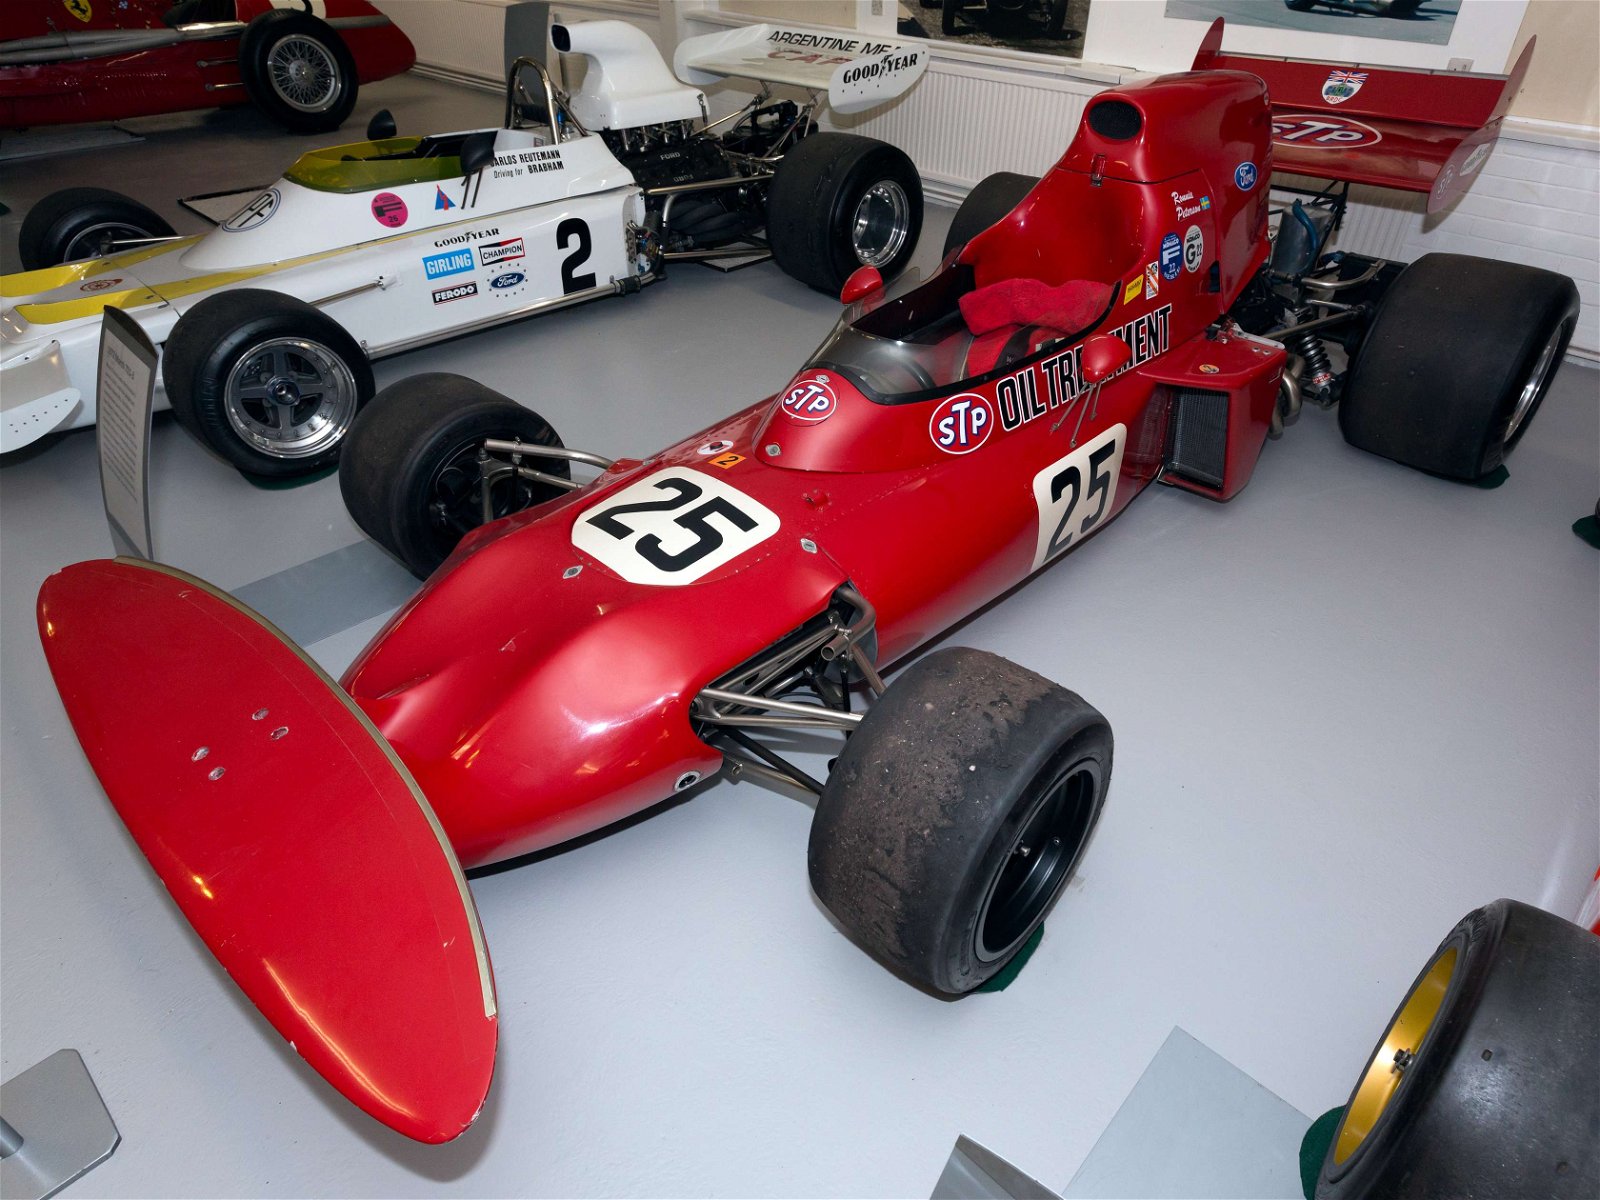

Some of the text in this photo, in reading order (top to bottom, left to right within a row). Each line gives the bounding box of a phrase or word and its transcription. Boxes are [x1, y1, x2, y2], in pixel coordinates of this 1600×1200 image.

[767, 31, 859, 52] ARGENTINE
[843, 53, 918, 84] GOODYEAR
[519, 149, 561, 163] REUTEMANN
[493, 160, 565, 179] Driving for BRABHAM
[1239, 165, 1255, 187] Ford
[434, 227, 501, 248] GOODYEAR
[482, 243, 523, 260] CHAMPION
[556, 217, 597, 295] 2
[1162, 245, 1181, 265] F
[1186, 243, 1197, 265] G
[426, 252, 472, 276] GIRLING
[497, 273, 520, 287] Ford
[434, 284, 475, 302] FERODO
[937, 303, 1172, 447] STP OIL TREMENT
[783, 384, 831, 413] STP
[716, 455, 740, 466] 2
[1043, 438, 1116, 564] 25
[585, 477, 760, 573] 25
